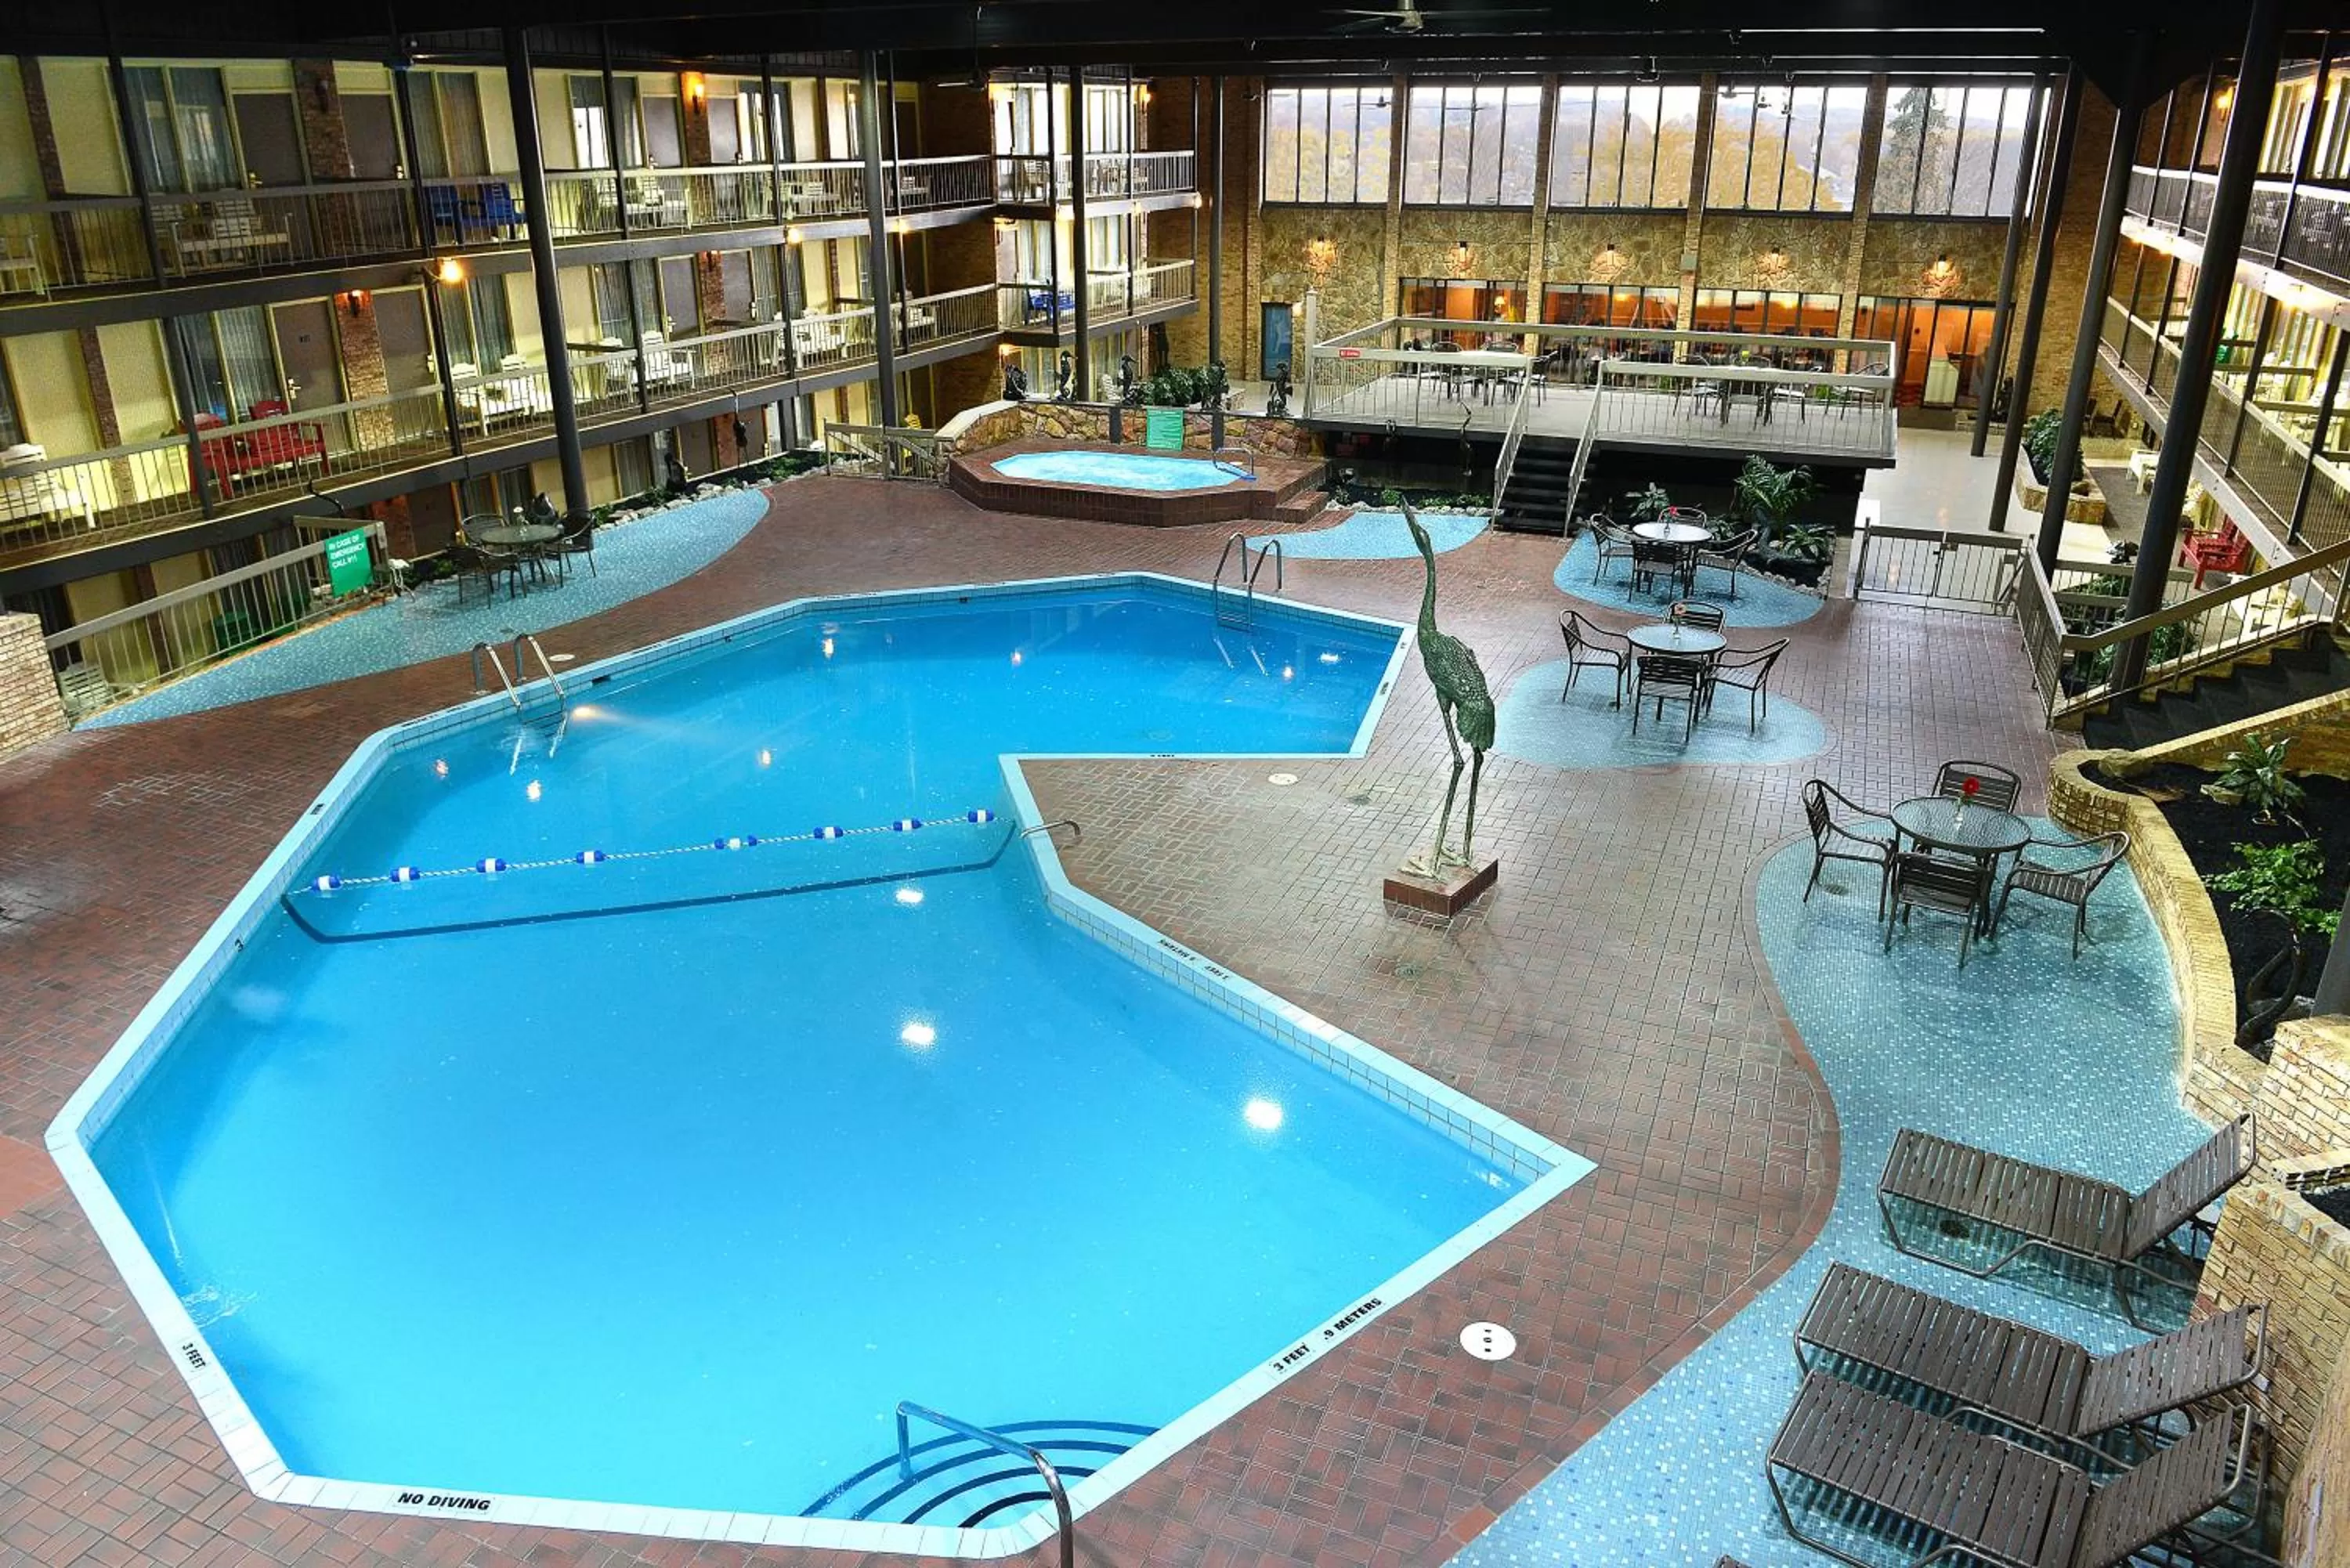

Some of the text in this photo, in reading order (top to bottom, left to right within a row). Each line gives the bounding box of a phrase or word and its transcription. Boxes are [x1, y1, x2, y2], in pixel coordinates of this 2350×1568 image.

[1273, 1297, 1383, 1371] 3 FEET .9 METERS
[182, 1342, 207, 1369] 3 FEET
[397, 1492, 491, 1511] NO DIVING
